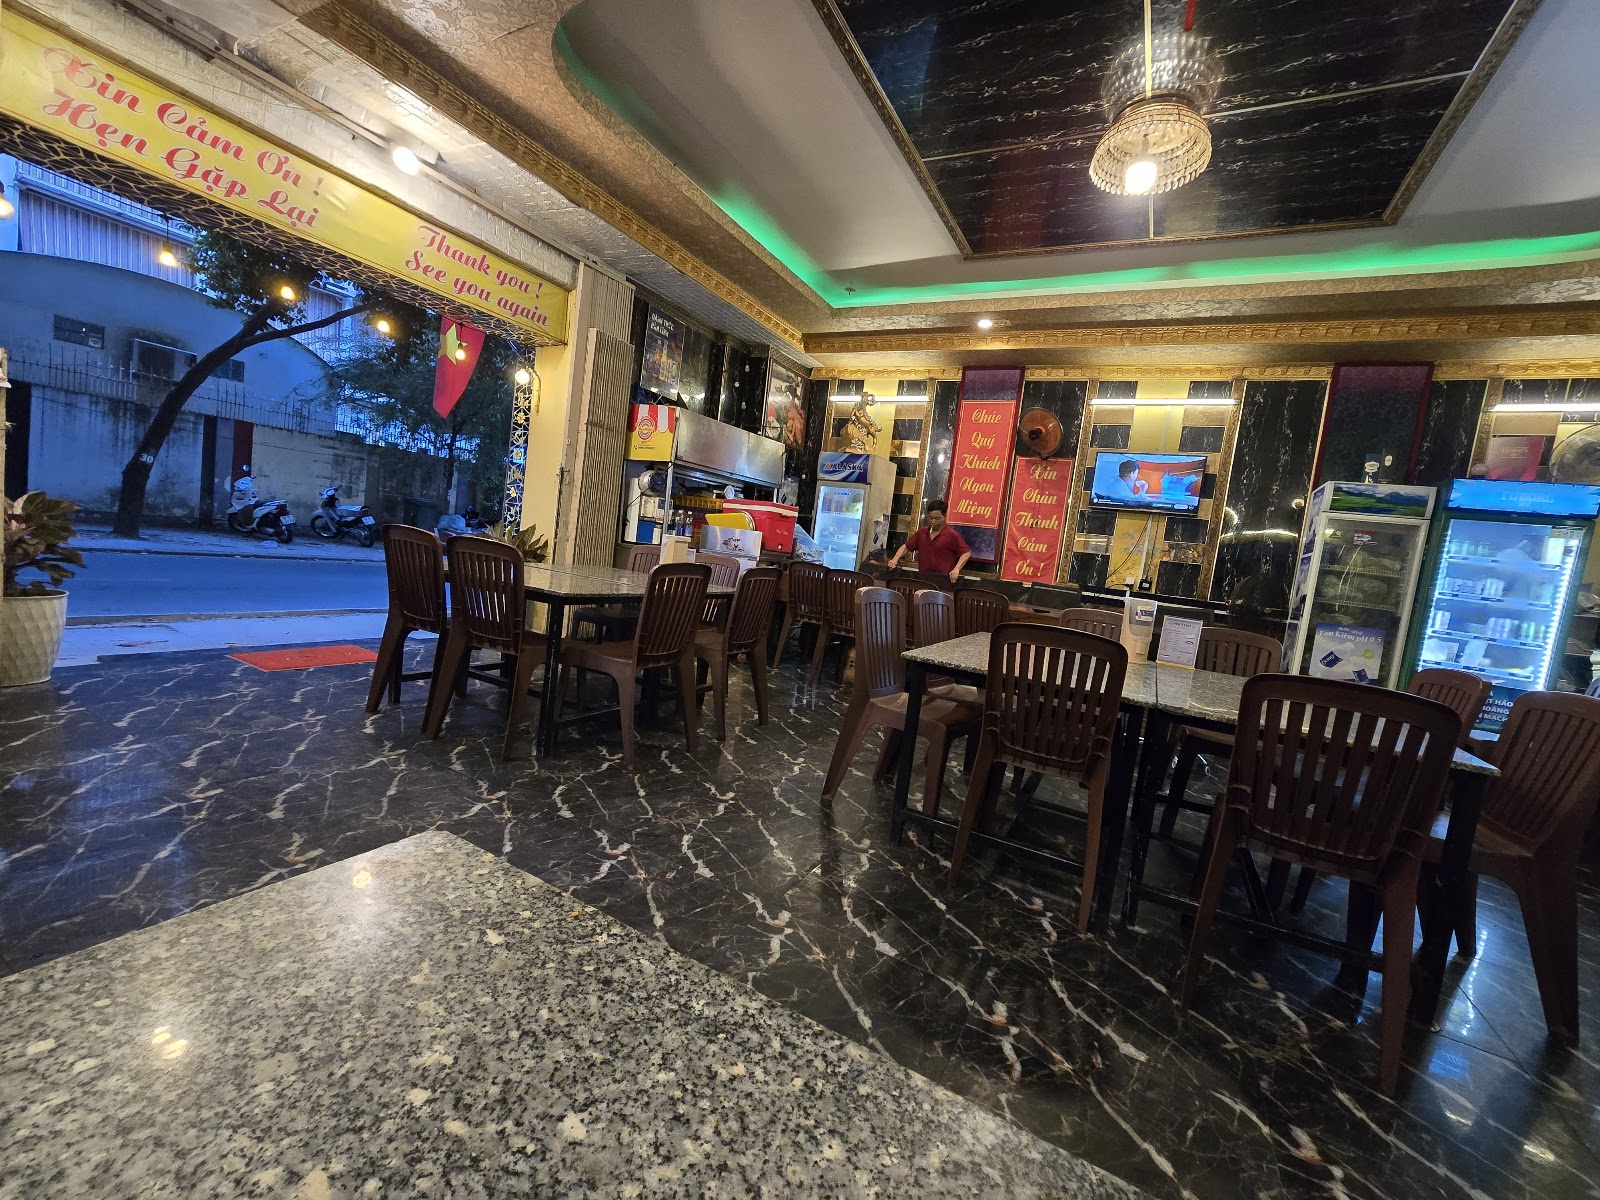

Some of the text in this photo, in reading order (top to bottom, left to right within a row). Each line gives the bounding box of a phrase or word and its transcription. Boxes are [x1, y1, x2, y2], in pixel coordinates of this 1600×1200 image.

[43, 47, 143, 113] Xin
[157, 102, 246, 162] Cảm
[257, 150, 303, 188] Ơn
[42, 87, 318, 228] Hẹn Gặp Lại
[417, 225, 491, 276] Thank
[496, 269, 531, 295] you
[404, 250, 548, 327] See you again
[972, 408, 1002, 424] Chúc
[970, 431, 996, 450] Quý
[140, 453, 154, 463] 30
[831, 462, 864, 472] ALASKA
[959, 453, 1001, 470] Khách
[1029, 463, 1057, 480] Xin
[960, 477, 994, 495] Ngon
[1022, 487, 1058, 505] Chân
[953, 499, 993, 518] Miệng
[1015, 511, 1059, 530] Thành
[1018, 536, 1048, 553] Cảm
